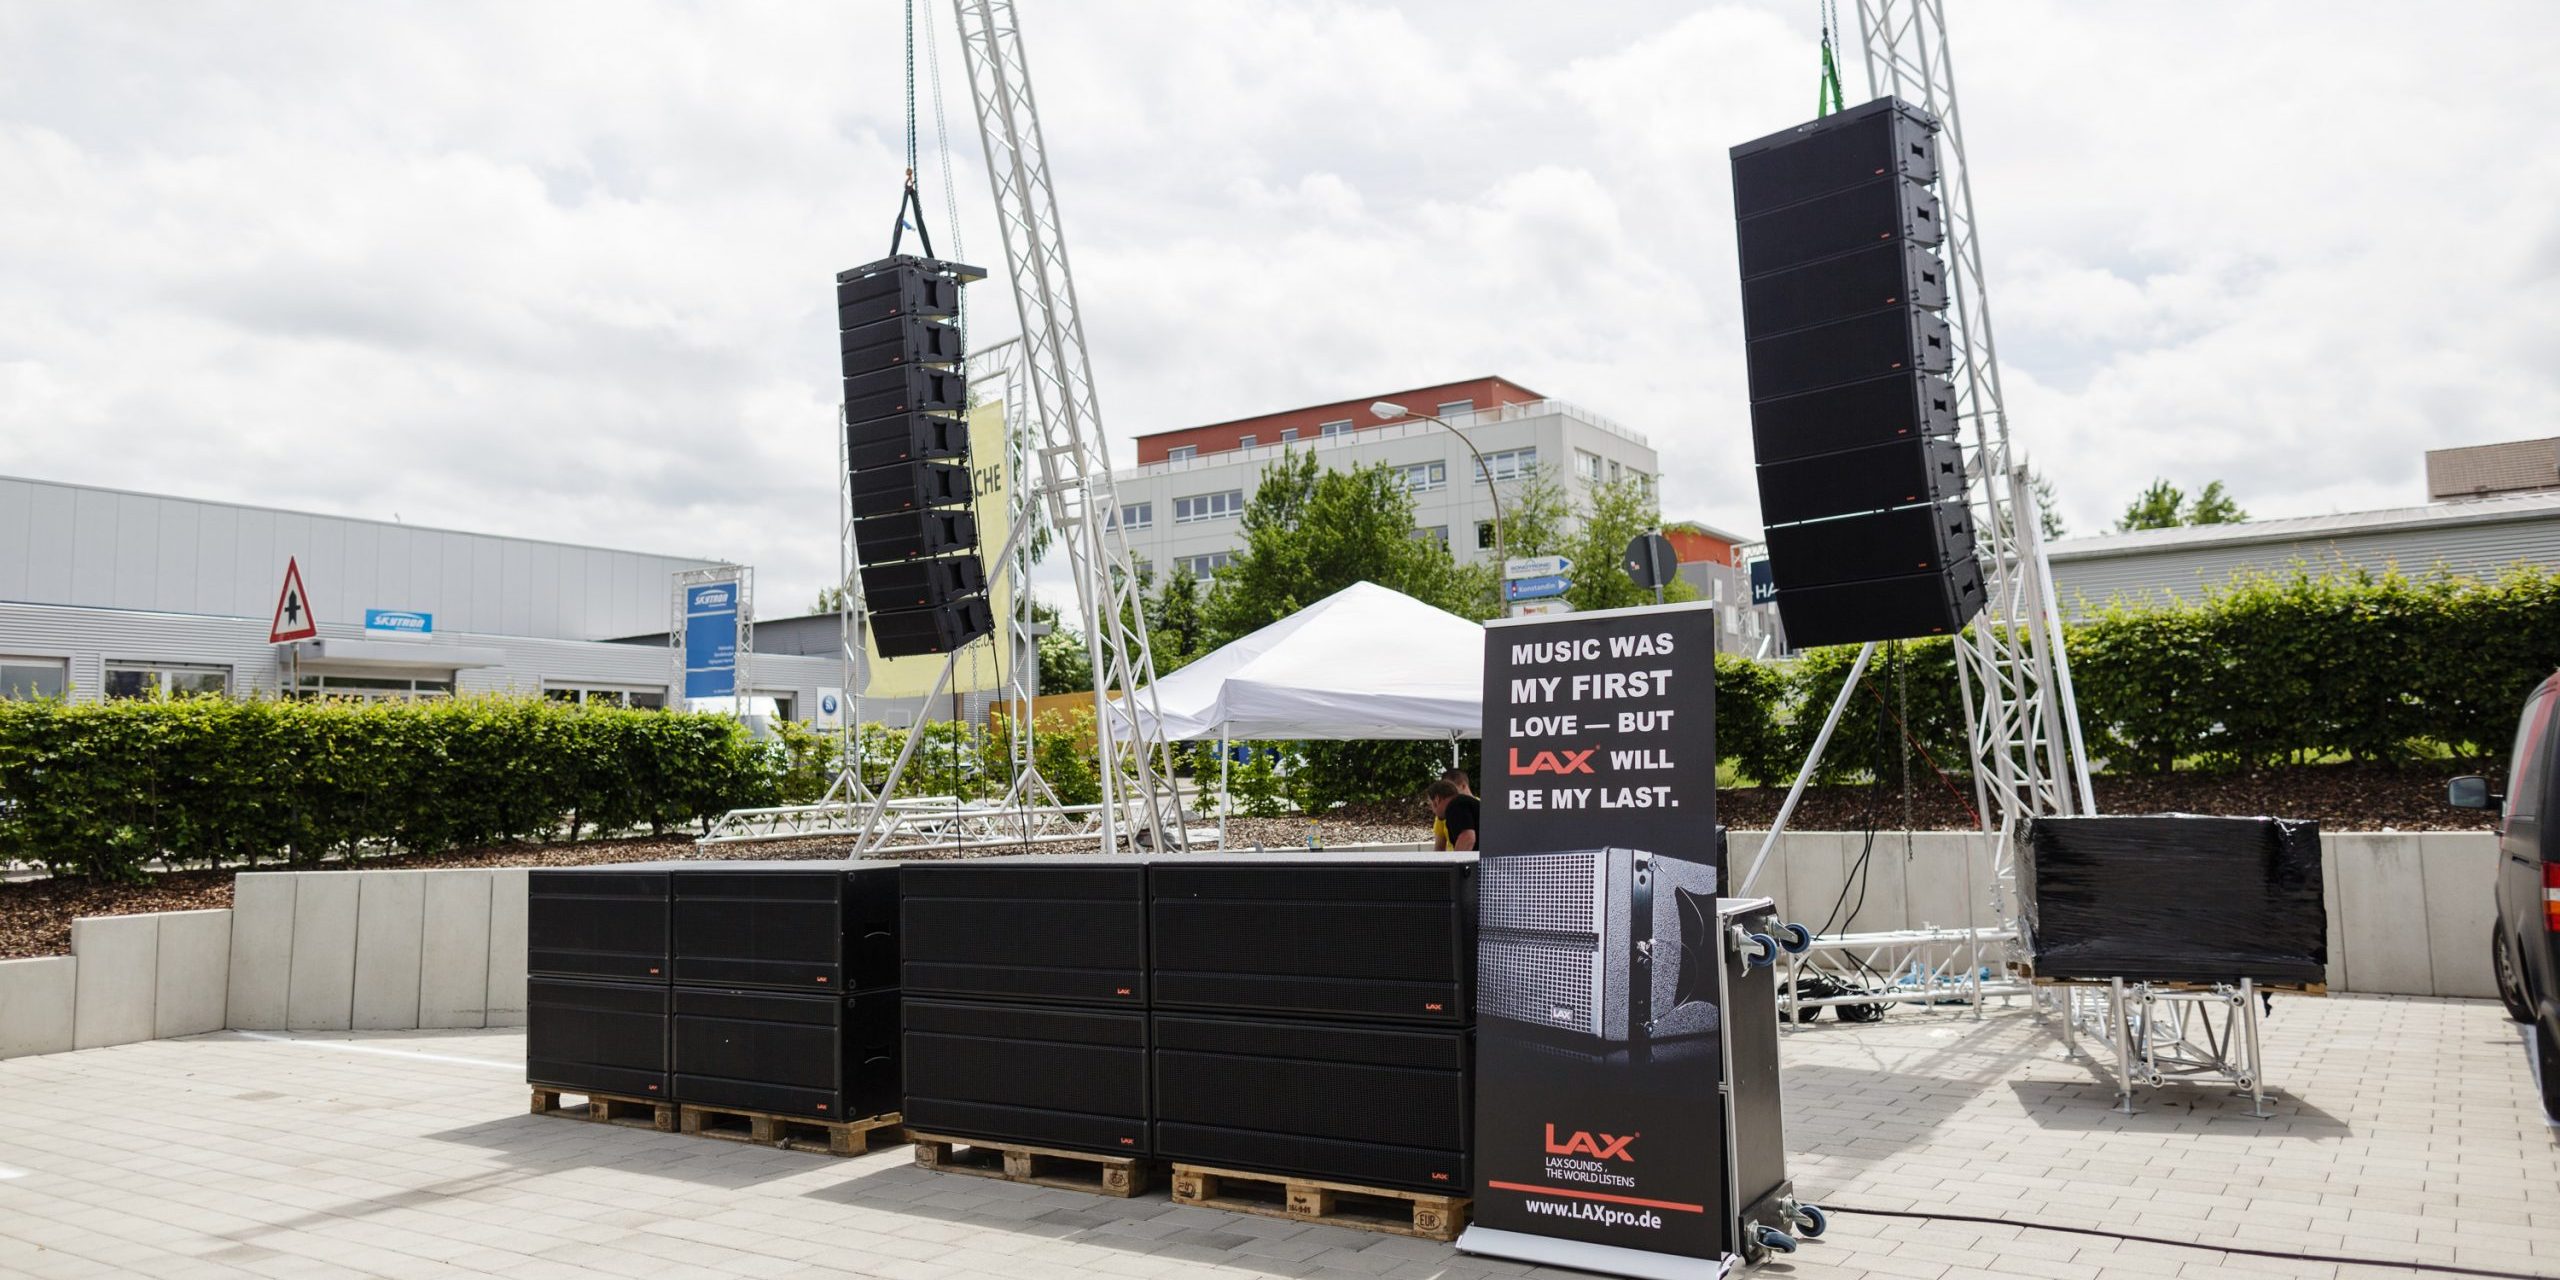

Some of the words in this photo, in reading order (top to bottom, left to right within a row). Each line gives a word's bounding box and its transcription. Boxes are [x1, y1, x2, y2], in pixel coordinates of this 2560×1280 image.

[694, 593, 728, 606] SKYTRON
[374, 616, 425, 628] SKYTRON
[1511, 638, 1600, 665] MUSIC
[1609, 633, 1674, 658] WAS
[1511, 676, 1562, 704] MY
[1572, 669, 1673, 701] FIRST
[1510, 715, 1577, 737] LOVE
[1618, 710, 1674, 733] BUT
[1509, 747, 1596, 776] LAX
[1610, 749, 1674, 770] WILL
[1508, 789, 1543, 810] BE
[1551, 788, 1592, 809] MY
[1600, 786, 1679, 808] LAST.
[1552, 1007, 1571, 1019] LAX
[1545, 1123, 1635, 1162] LAX
[1545, 1157, 1563, 1168] LAX
[1545, 1167, 1563, 1179] THE
[1563, 1170, 1598, 1183] WORLD
[1599, 1174, 1635, 1187] LISTENS
[1419, 1214, 1435, 1227] EUR
[1525, 1200, 1661, 1229] www.LAXpro.de
